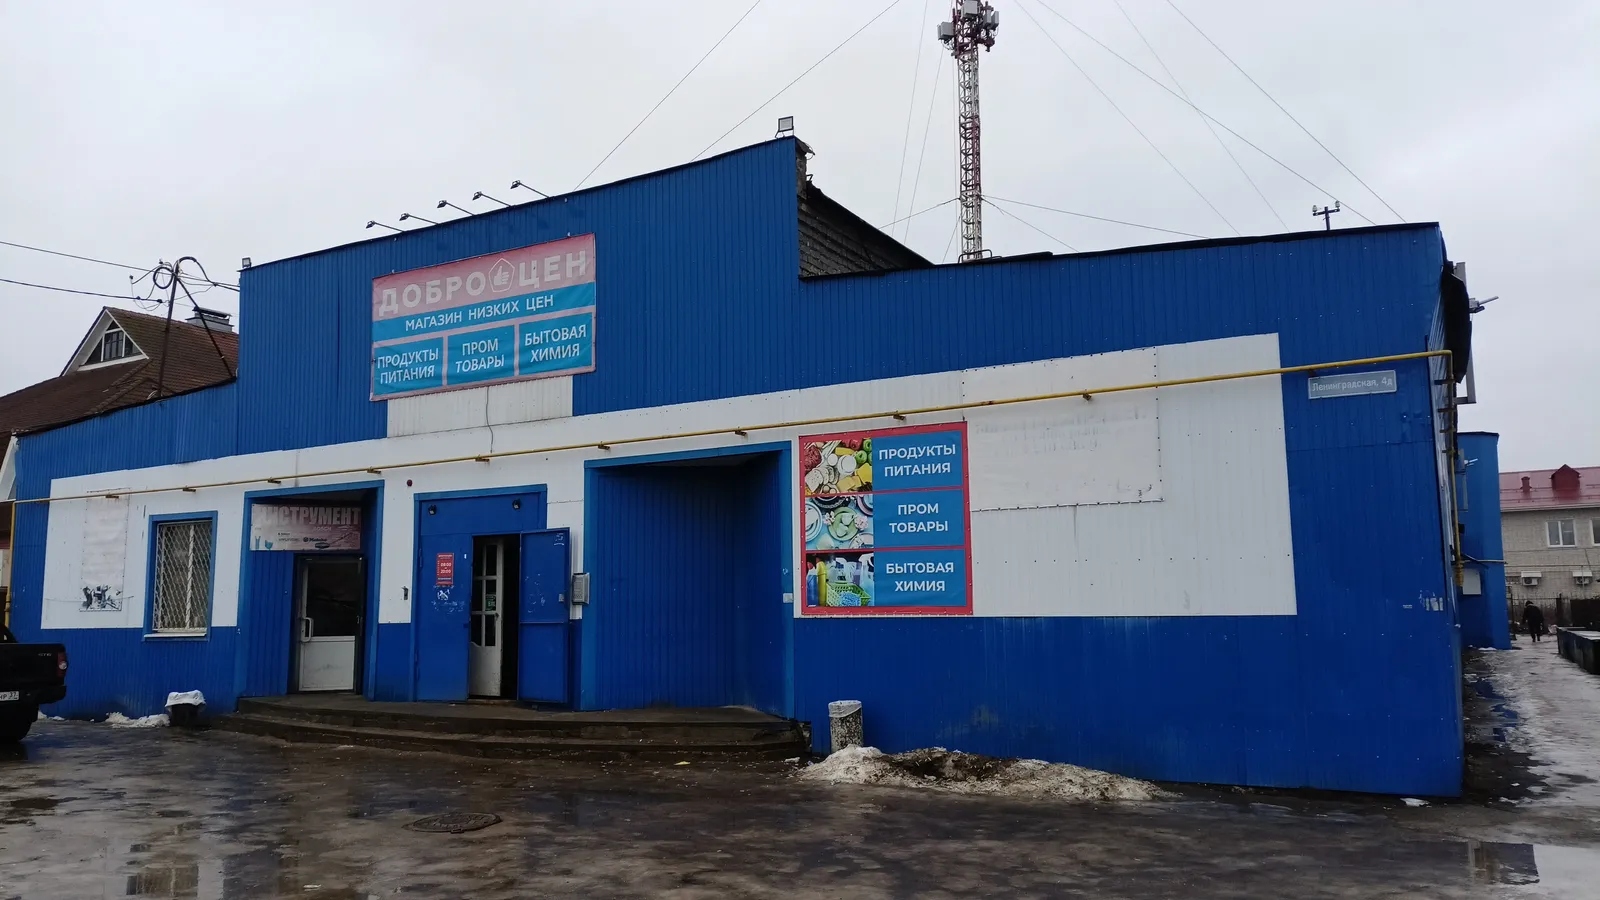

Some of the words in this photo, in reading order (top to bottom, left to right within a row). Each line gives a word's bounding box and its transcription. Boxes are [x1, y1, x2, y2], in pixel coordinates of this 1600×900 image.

[378, 271, 486, 317] ДОБРО
[518, 250, 587, 289] ЦЕН
[405, 312, 462, 332] МАГАЗИН
[468, 300, 520, 321] НИЗКИХ
[526, 294, 554, 312] ЦЕН
[524, 324, 587, 346] БЫТОВАЯ
[462, 338, 499, 356] ПРОМ
[530, 343, 580, 363] ХИМИЯ
[377, 348, 439, 369] ПРОДУКТЫ
[455, 355, 505, 374] ТОВАРЫ
[380, 366, 435, 385] ПИТАНИЯ
[1312, 379, 1379, 392] Ленинградская,
[1381, 376, 1393, 386] 4д
[878, 444, 956, 460] ПРОДУКТЫ
[884, 462, 951, 478] ПИТАНИЯ
[897, 503, 939, 515] ПРОМ
[889, 520, 948, 534] ТОВАРЫ
[885, 561, 954, 574] БЫТОВАЯ
[894, 580, 946, 592] ХИМИЯ
